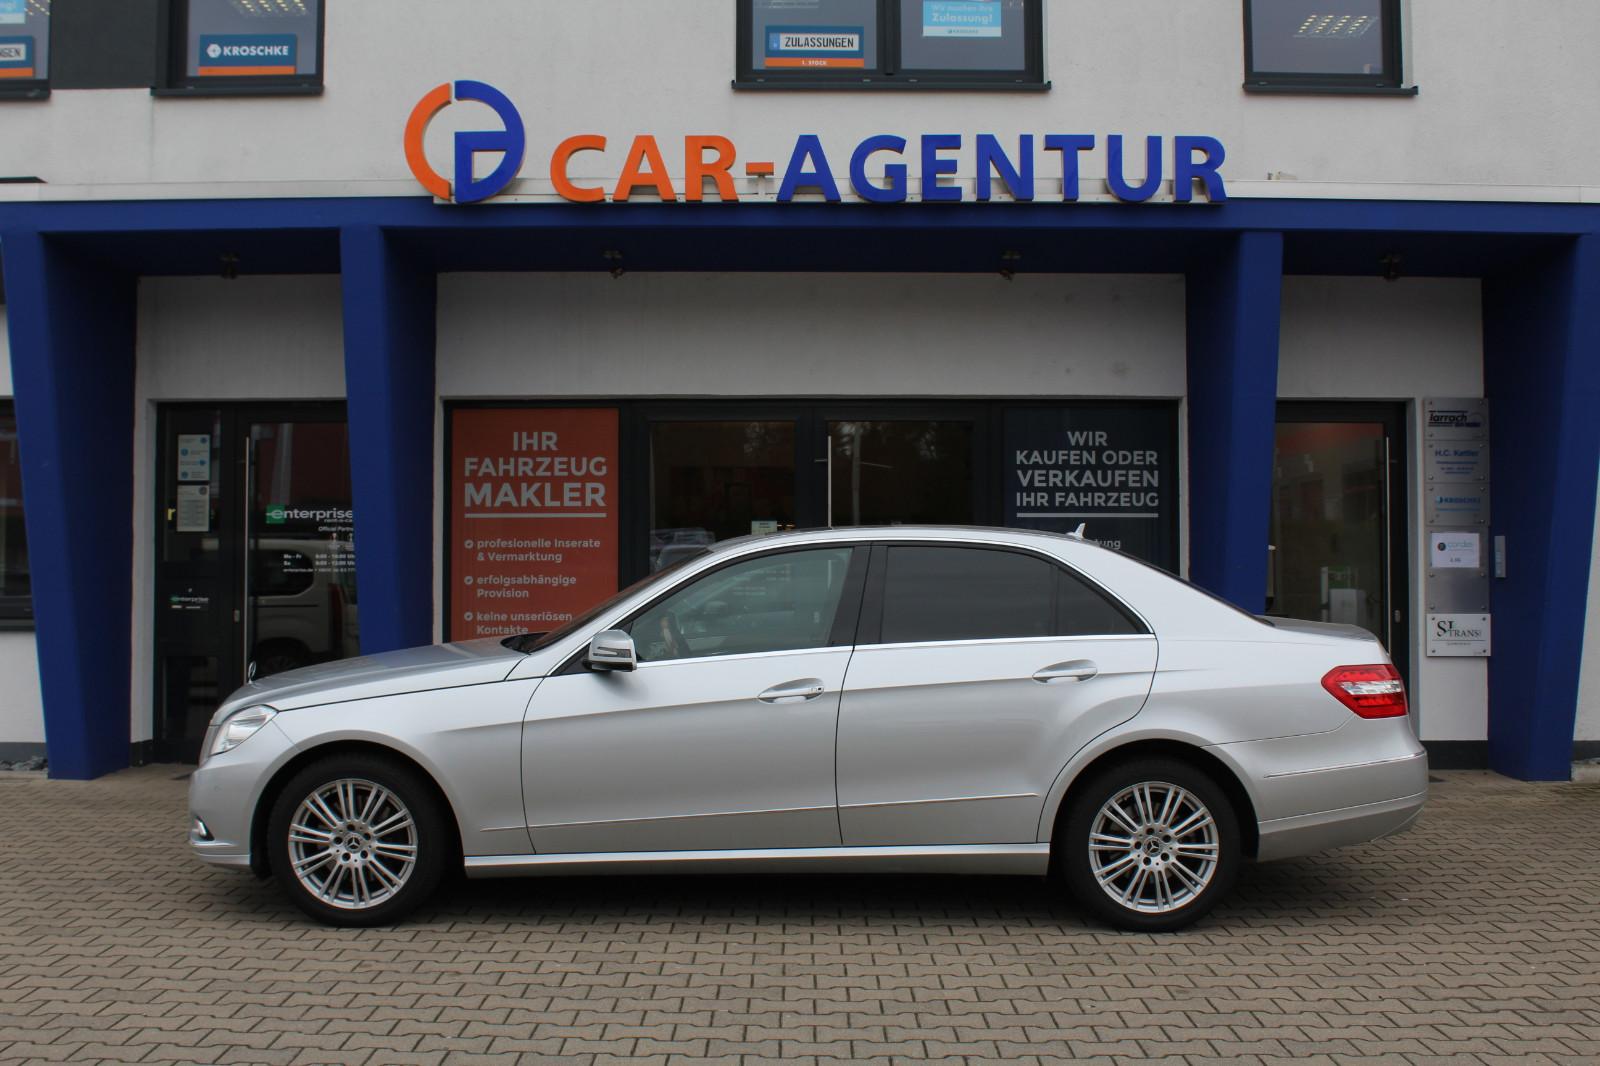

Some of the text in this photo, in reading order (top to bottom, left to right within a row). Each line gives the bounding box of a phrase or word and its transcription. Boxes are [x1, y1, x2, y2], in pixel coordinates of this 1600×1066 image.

[932, 13, 993, 24] Zulassung!
[785, 36, 854, 48] ZULASSUNGEN
[223, 45, 289, 57] KROSCHKE
[550, 133, 1229, 205] CAR-AGENTUR
[513, 431, 558, 451] IHR
[1067, 431, 1108, 446] WIR
[1016, 450, 1158, 465] KAUFEN ODER
[464, 457, 607, 477] FAHRZEUG
[1016, 469, 1159, 487] VERKAUFEN
[464, 482, 606, 507] MAKLER
[1016, 492, 1159, 507] IHR FAHRZEUG
[554, 538, 601, 548] Inserate
[477, 552, 562, 563] & Vermarktung
[477, 575, 577, 586] erfolgsabhängige
[477, 588, 529, 598] Provision
[477, 611, 573, 621] keine unseriösen
[477, 624, 529, 635] Kontakte
